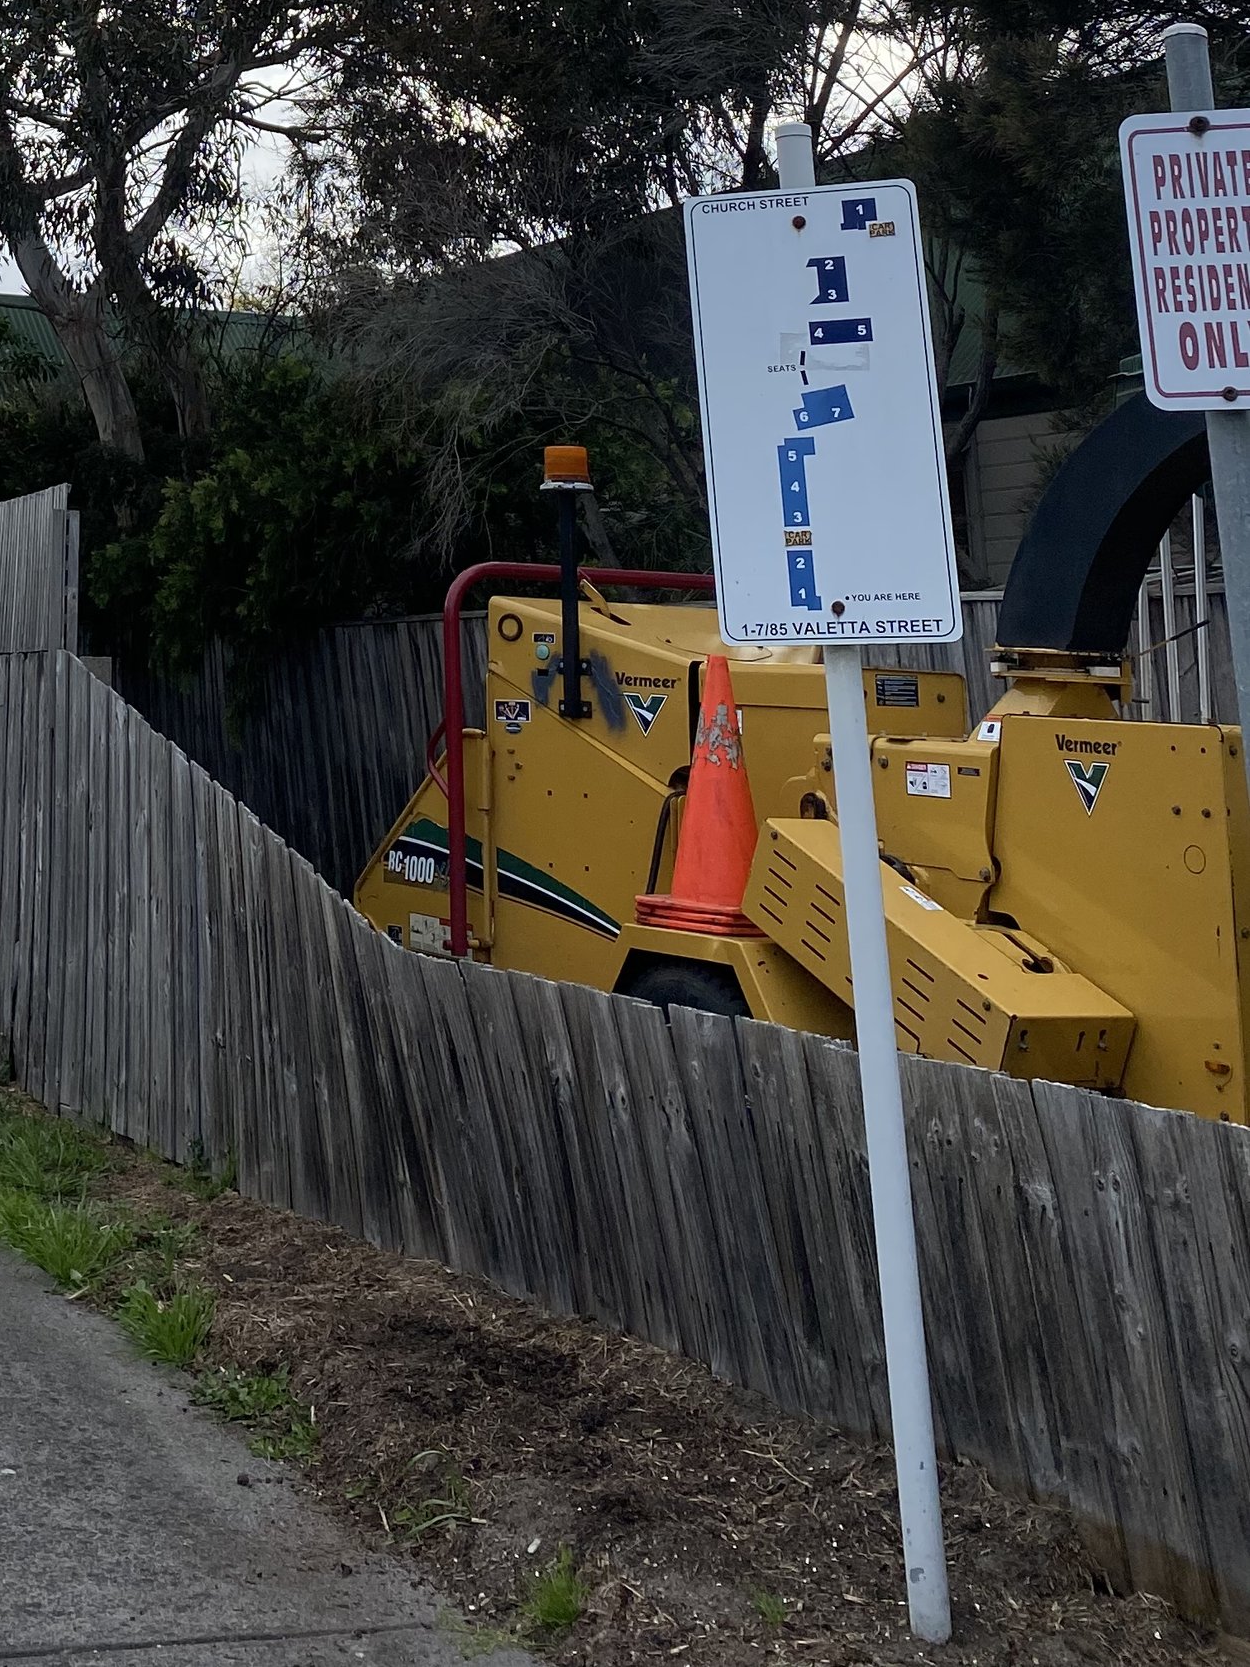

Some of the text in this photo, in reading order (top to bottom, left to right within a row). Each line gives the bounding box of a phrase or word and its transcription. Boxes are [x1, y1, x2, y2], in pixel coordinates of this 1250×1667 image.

[1152, 150, 1250, 200] PRIVATE
[702, 196, 810, 214] CHURCH STREET
[855, 204, 864, 215] 1
[872, 222, 891, 230] CAR
[1149, 206, 1250, 256] PROPERT
[824, 259, 835, 270] 2
[827, 289, 837, 300] 3
[814, 325, 867, 338] 4 5
[1179, 321, 1250, 370] ONL
[767, 364, 797, 373] SEATS
[799, 407, 841, 422] 6 7
[788, 450, 797, 461] 5
[790, 481, 800, 492] 4
[793, 511, 803, 523] 3
[788, 530, 808, 538] CAR
[795, 557, 806, 569] 2
[798, 587, 806, 599] 1
[851, 592, 921, 602] YOU ARE HERE
[741, 619, 943, 636] 1-7/85 VALETTA STREET
[615, 672, 677, 689] Vermeer
[1055, 734, 1118, 756] Vermeer
